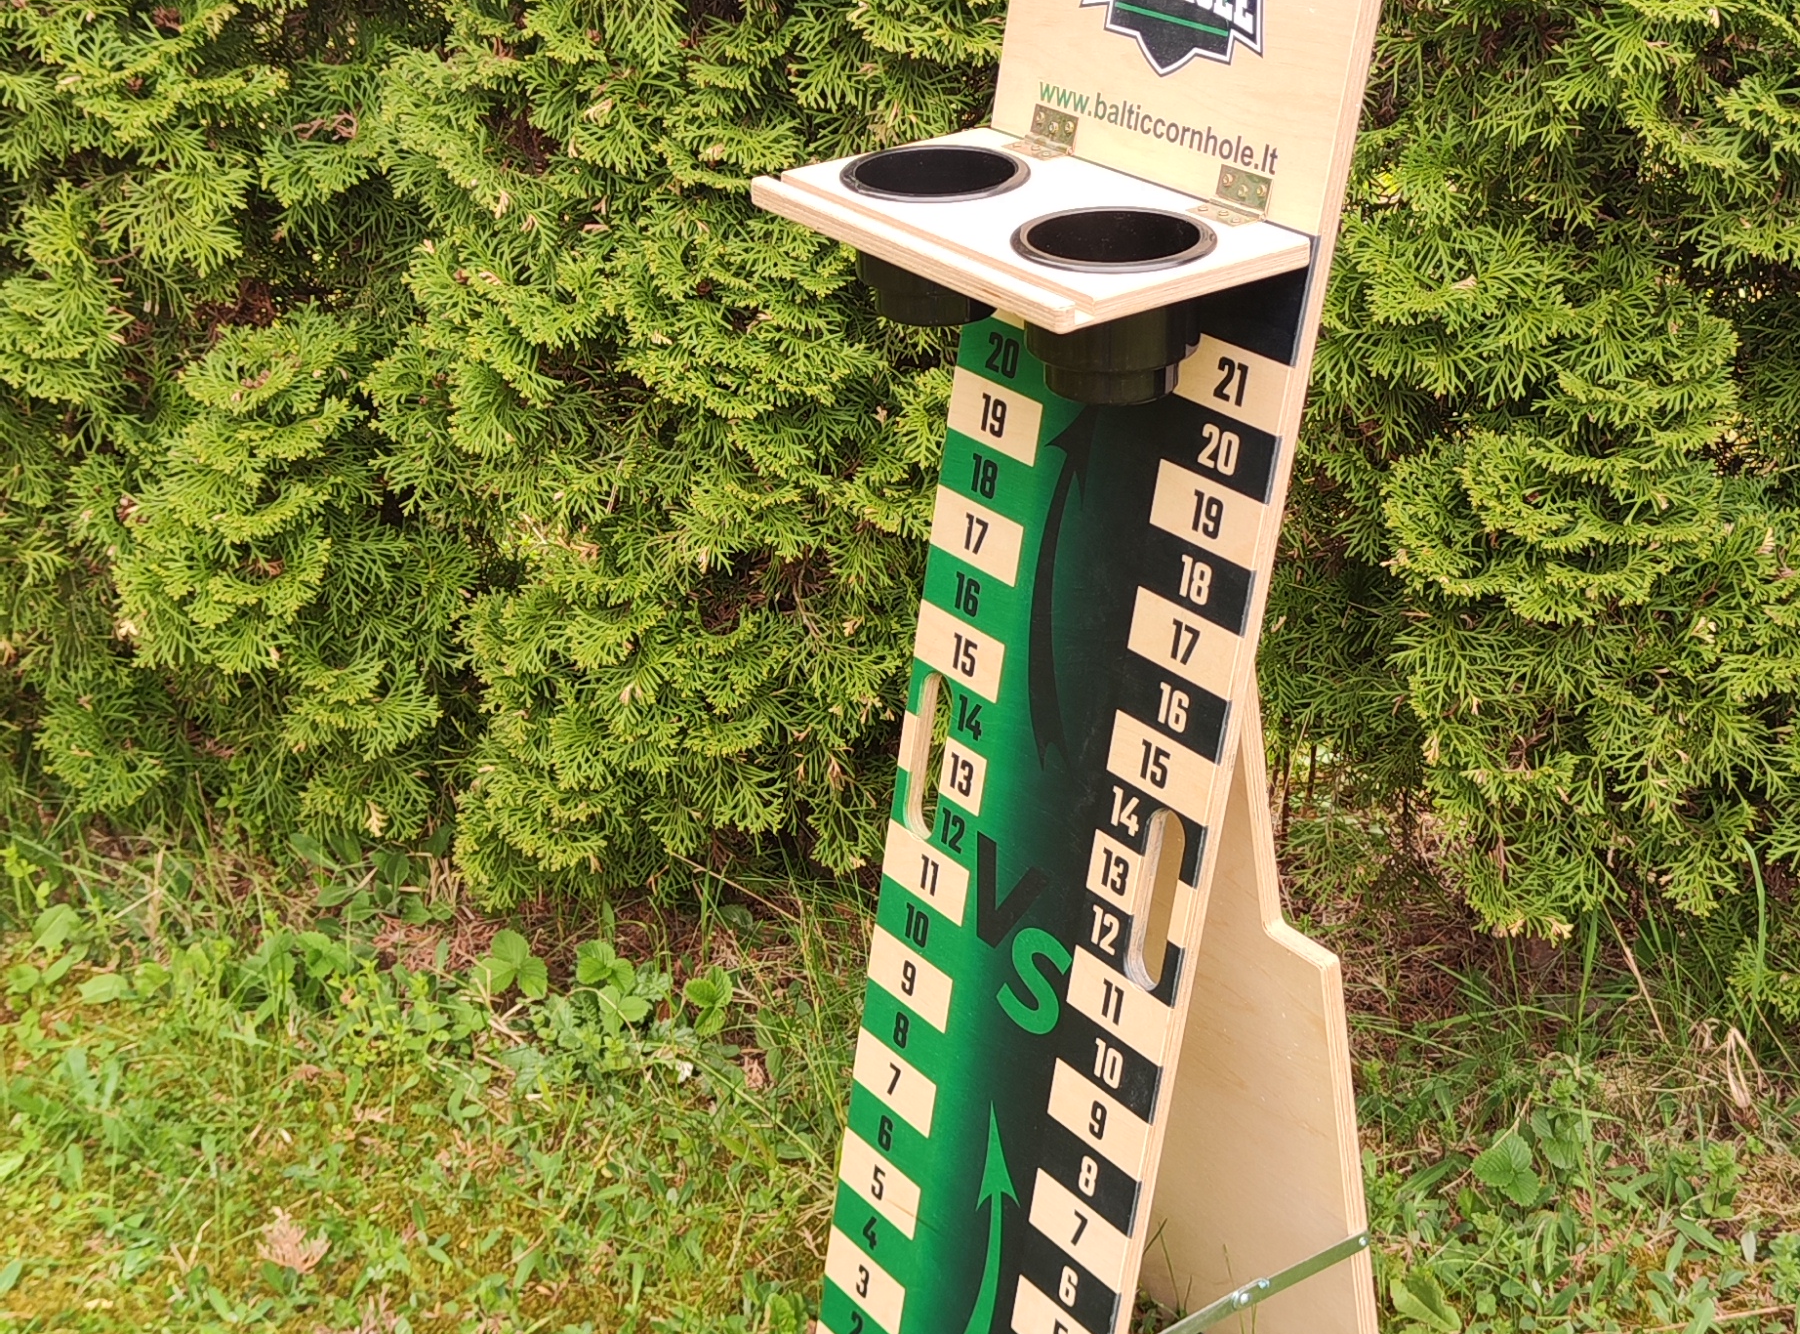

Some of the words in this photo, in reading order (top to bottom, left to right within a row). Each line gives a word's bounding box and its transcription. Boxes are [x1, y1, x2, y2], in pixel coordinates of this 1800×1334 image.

[1039, 81, 1279, 175] www.balticcornhole.lt
[984, 331, 1018, 378] 20
[1212, 355, 1250, 408] 21
[981, 392, 1007, 438] 19
[1197, 422, 1239, 477] 20
[971, 452, 998, 500] 18
[964, 511, 989, 555] 17
[1191, 488, 1224, 541] 19
[954, 570, 981, 618] 16
[1178, 553, 1212, 606] 18
[952, 632, 978, 677] 15
[1171, 617, 1200, 665] 17
[957, 693, 982, 741] 14
[1157, 680, 1189, 733] 16
[949, 753, 974, 798] 13
[1138, 738, 1170, 789] 15
[941, 807, 965, 854] 12
[1111, 785, 1140, 838] 14
[920, 853, 940, 896] 11
[1101, 847, 1129, 897] 13
[905, 901, 929, 948] 10
[1091, 905, 1119, 956] 12
[900, 960, 917, 997] 9
[1101, 978, 1125, 1027] 11
[893, 1011, 910, 1049] 8
[886, 1062, 902, 1096] 7
[1093, 1037, 1124, 1090] 10
[877, 1114, 894, 1152] 6
[1089, 1100, 1107, 1141] 9
[870, 1164, 887, 1201] 5
[1078, 1155, 1098, 1198] 8
[861, 1216, 877, 1250] 4
[1070, 1209, 1089, 1247] 7
[855, 1264, 870, 1299] 3
[1059, 1265, 1078, 1308] 6
